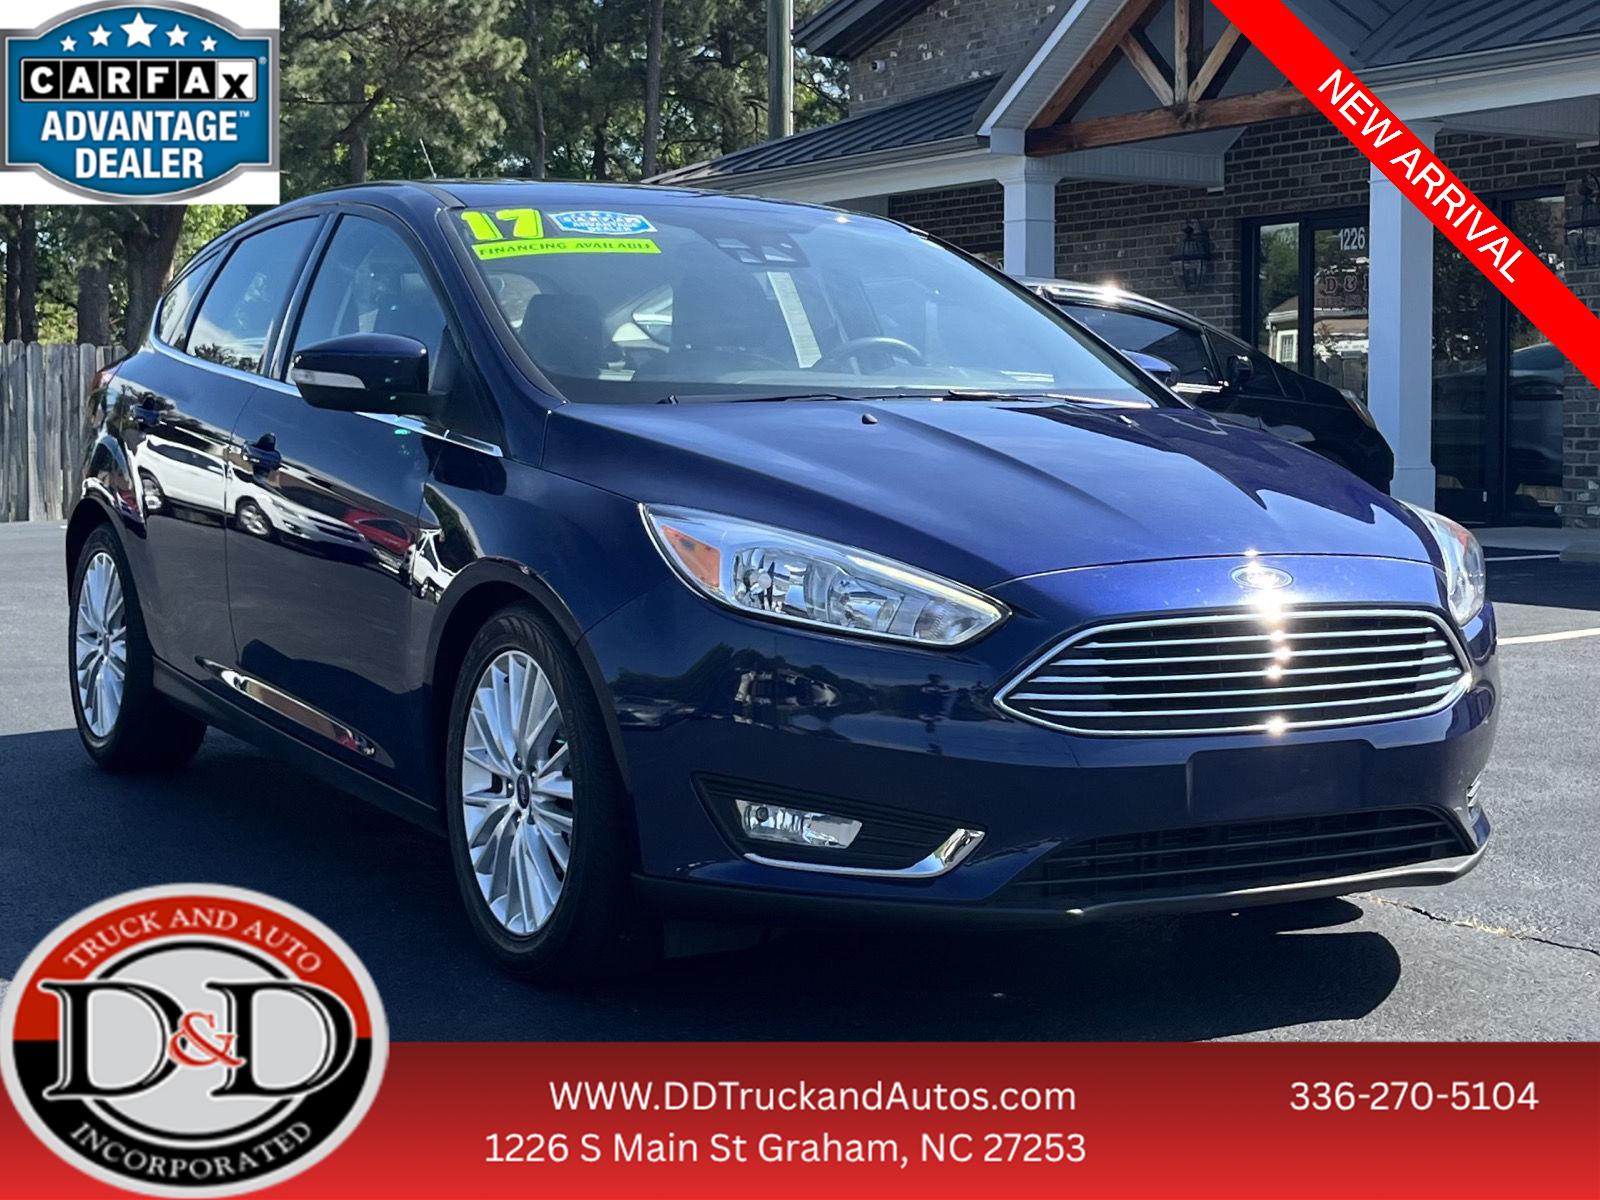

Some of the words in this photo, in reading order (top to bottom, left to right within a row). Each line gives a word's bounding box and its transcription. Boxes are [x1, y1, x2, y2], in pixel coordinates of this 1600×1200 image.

[461, 208, 544, 240] 17
[479, 242, 567, 256] FINANCING
[1339, 227, 1366, 251] 1226
